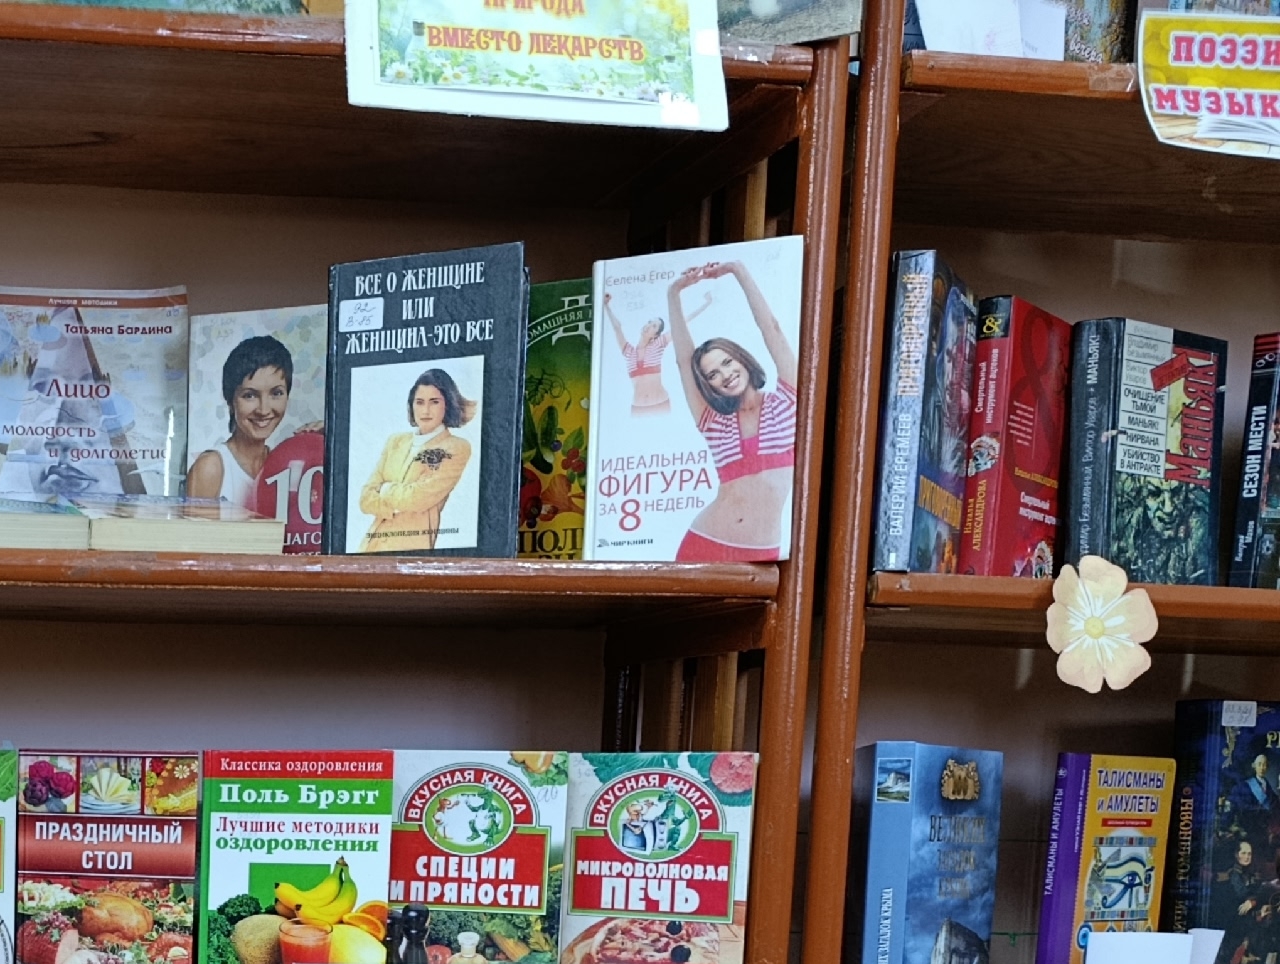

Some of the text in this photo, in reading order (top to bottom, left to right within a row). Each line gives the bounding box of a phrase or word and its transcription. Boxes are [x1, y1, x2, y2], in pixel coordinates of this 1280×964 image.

[427, 25, 644, 61] ВМЕСТО ЛЕКАРСТВ
[1153, 87, 1280, 118] МУЗЫК
[355, 262, 485, 297] ВСЕ О ЖЕНЩИНЕ
[605, 269, 675, 287] Селена Егер
[402, 297, 435, 320] ИЛИ
[65, 323, 172, 336] Татьяна Бардина
[466, 319, 494, 342] ВСЕ
[1086, 334, 1100, 385] МАНЬЯК!
[46, 378, 111, 399] Лицо
[975, 361, 988, 413] Смертельный
[1124, 388, 1166, 405] ОЧИЩЕНИЕ
[1132, 400, 1156, 414] ТЬМОЙ
[2, 425, 96, 439] молодость
[1128, 416, 1159, 430] МАНЬЯК!
[1126, 433, 1160, 446] НИРВАНА
[1243, 405, 1267, 498] СЕЗОН МЕСТИ
[601, 450, 708, 473] ИДЕАЛЬНАЯ
[1120, 459, 1161, 475] В АНТРАКТЕ
[1123, 448, 1160, 463] УБИЙСТВО
[599, 468, 712, 498] ФИГУРА
[889, 412, 912, 537] ВАЛЕРИЙ ЕРЕМЕЕВ
[599, 496, 705, 531] ЗА 8 НЕДЕЛЬ
[964, 498, 975, 535] Наталья
[973, 479, 987, 551] АЛЕКСАНДРОВА
[220, 758, 383, 774] Классика оздоровления
[1097, 769, 1166, 790] ТАЛИСМАНЫ
[220, 785, 379, 810] Поль Брэгг
[408, 769, 527, 820] ВКУСНАЯ КНИГА
[594, 775, 714, 826] ВКУСНАЯ КНИГА
[1107, 795, 1160, 813] АМУЛЕТЫ
[35, 821, 182, 845] ПРАЗДНИЧНЫЙ
[216, 816, 380, 834] Лучшие методики
[216, 836, 379, 855] оздоровления
[1044, 788, 1064, 895] ТАЛИСМАНЫ АМУЛЕТЫ
[82, 850, 132, 870] СТОЛ
[415, 856, 515, 882] СПЕЦИИ
[576, 860, 728, 882] МИКРОВОЛНОВАЯ
[410, 882, 539, 908] ПРЯНОСТИ
[600, 878, 701, 914] ПЕЧЬ
[882, 888, 893, 915] КРЫМА
[879, 915, 891, 955] ЗАГАДОК
